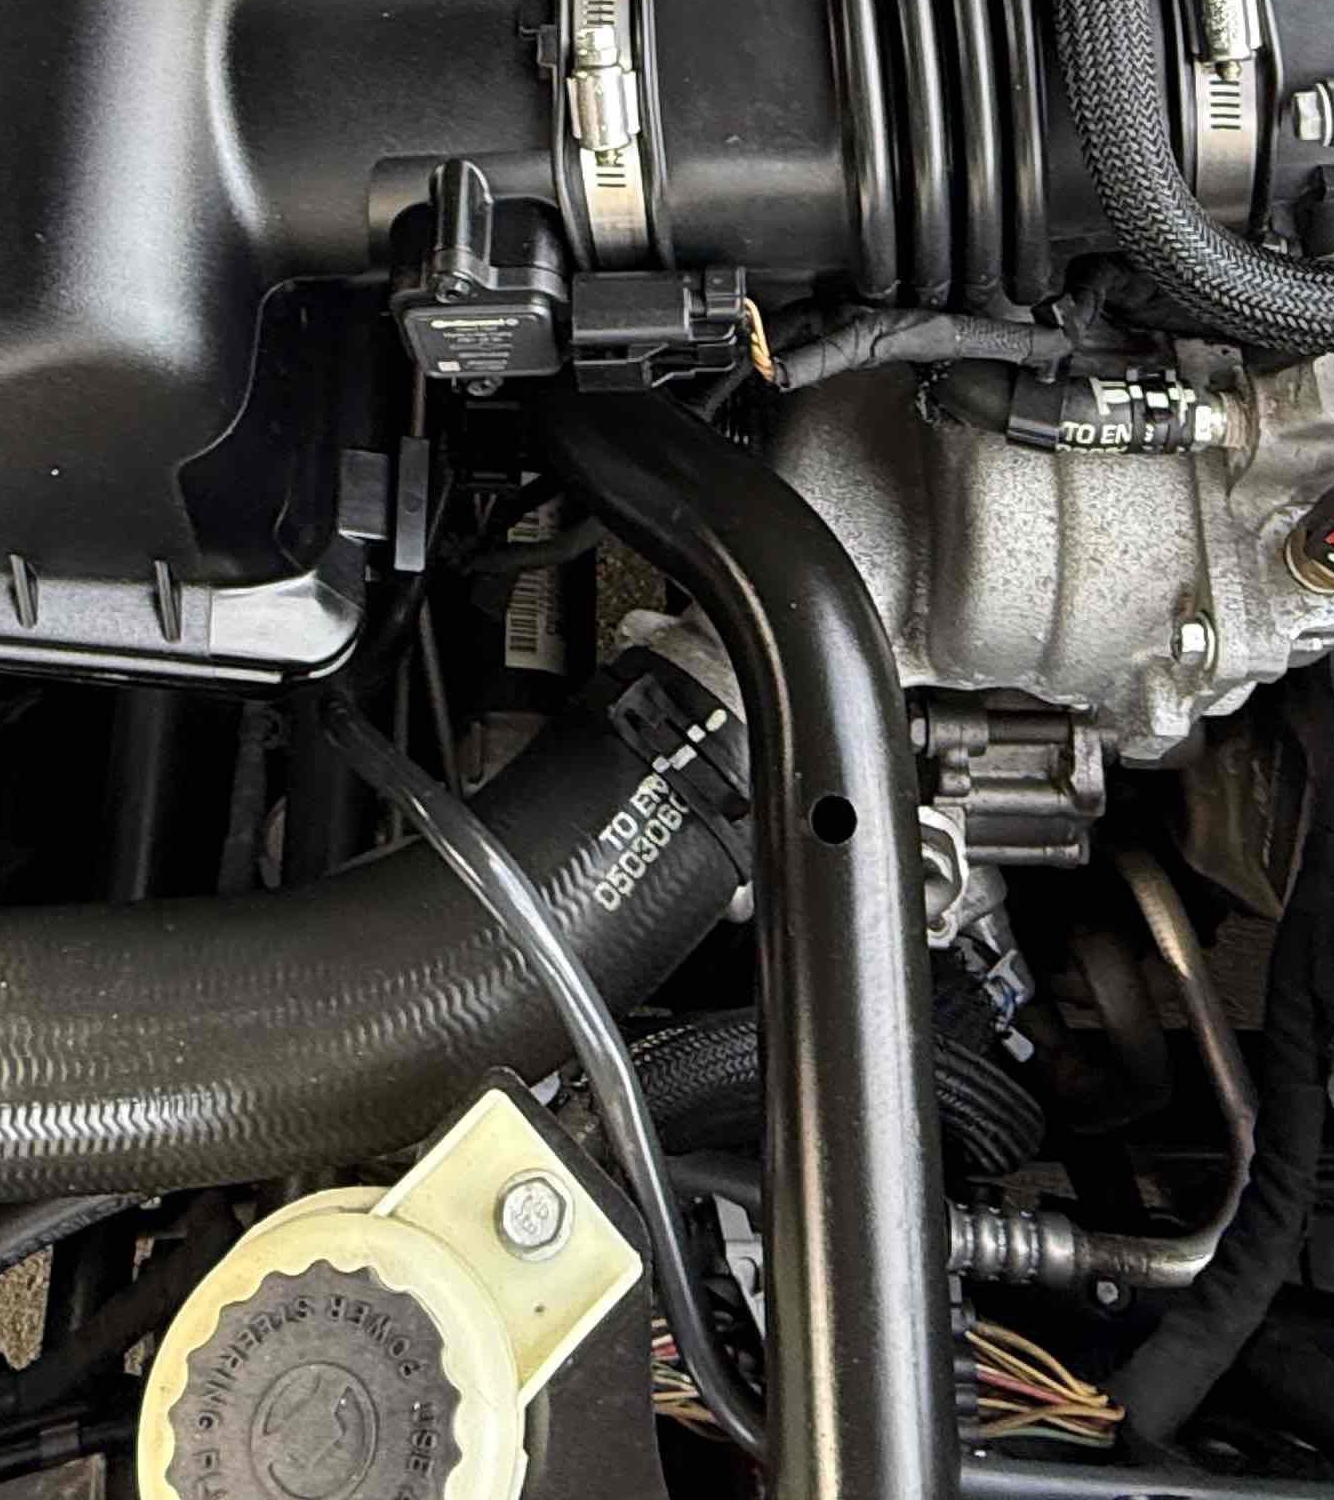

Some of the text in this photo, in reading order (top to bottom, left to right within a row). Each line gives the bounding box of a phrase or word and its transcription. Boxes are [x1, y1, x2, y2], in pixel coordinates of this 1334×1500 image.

[1061, 421, 1095, 444] TO
[598, 811, 638, 851] TO
[196, 1297, 313, 1431] STEERING
[327, 1293, 422, 1377] POWER
